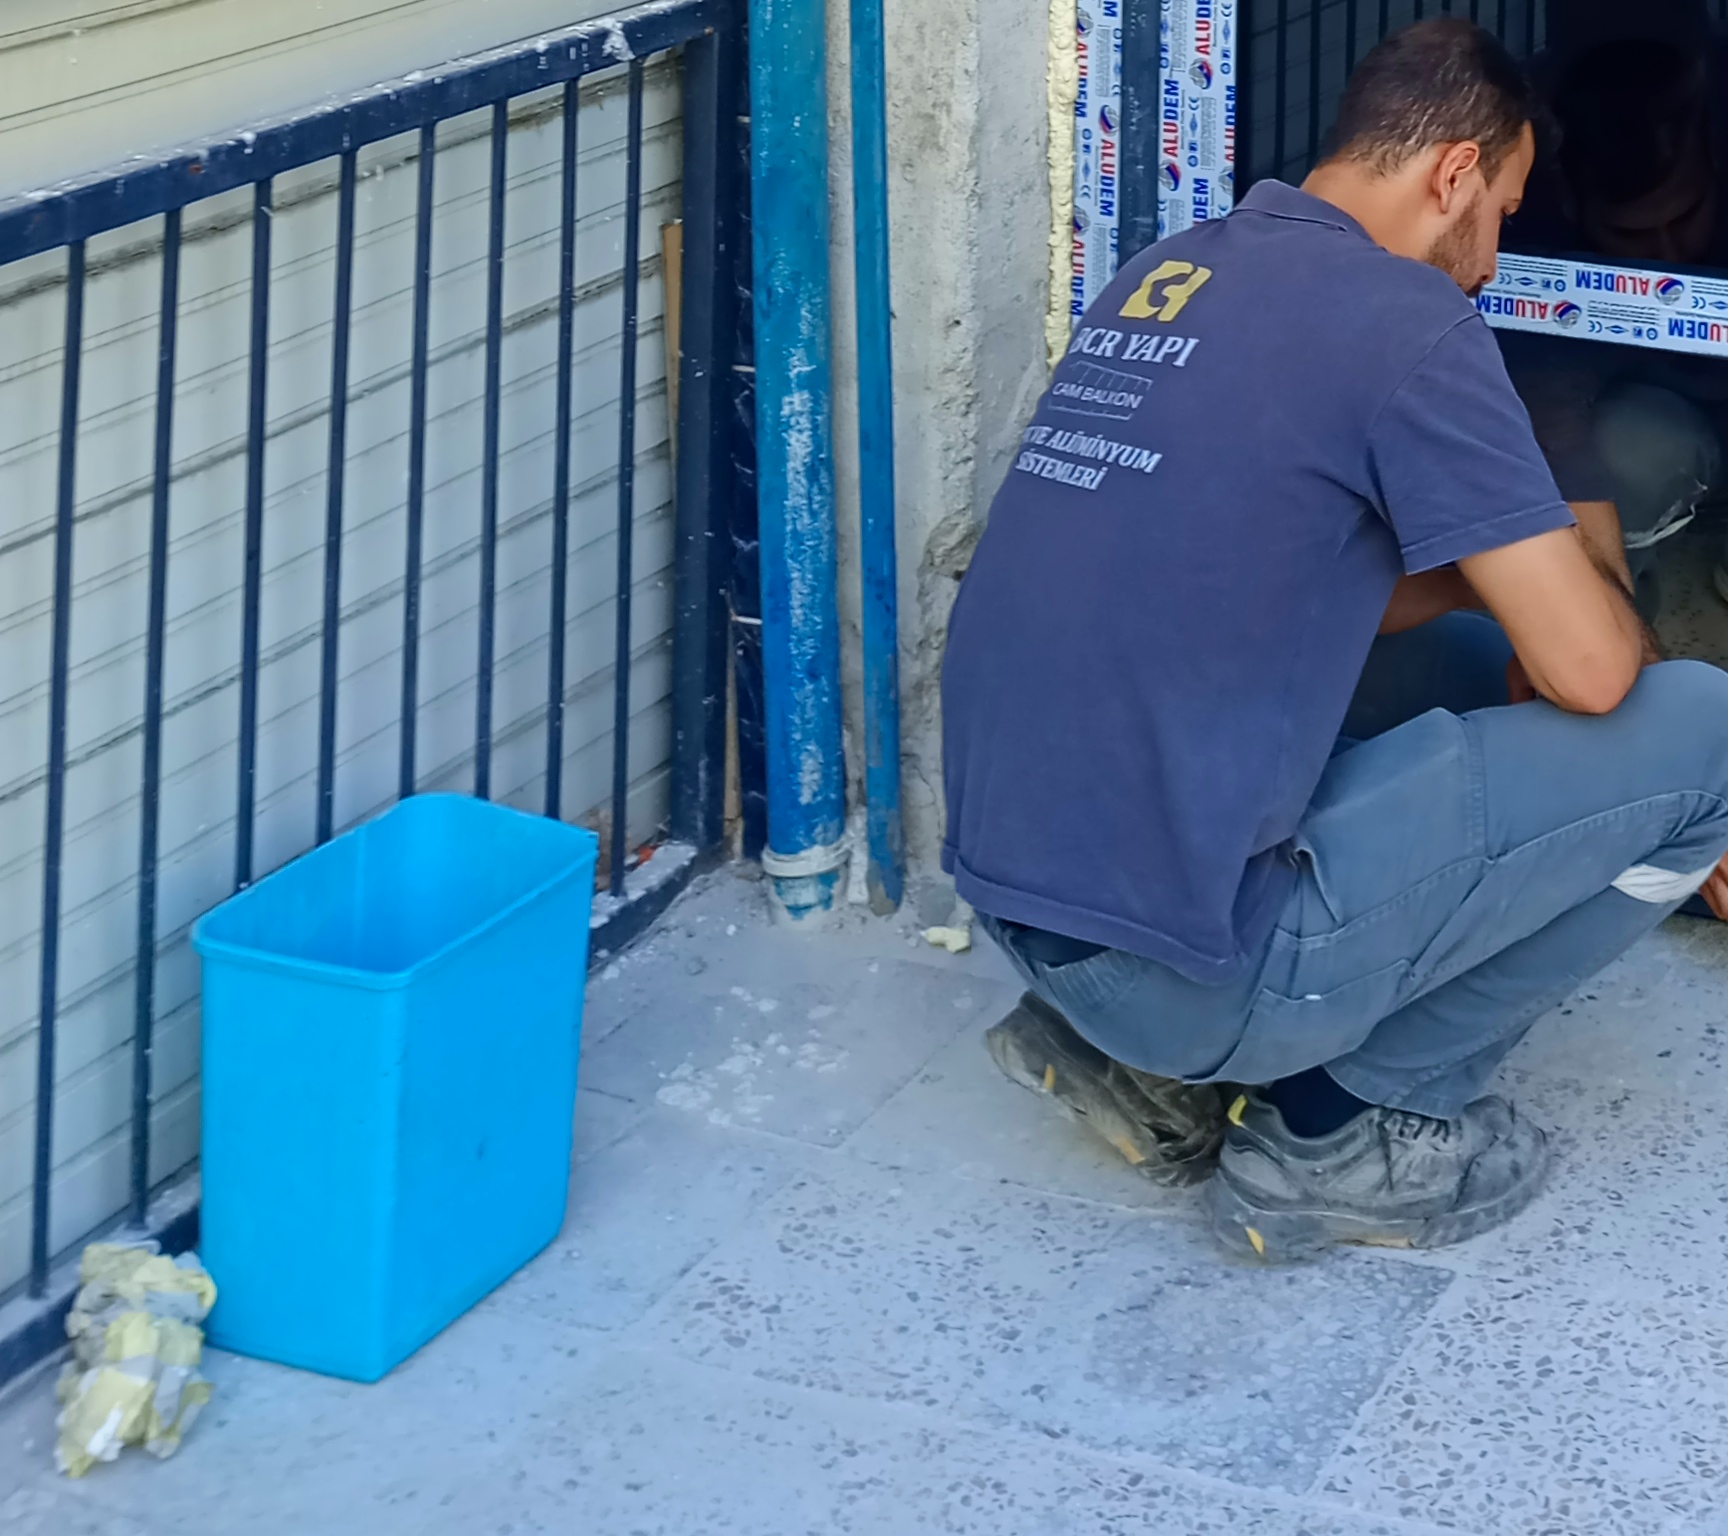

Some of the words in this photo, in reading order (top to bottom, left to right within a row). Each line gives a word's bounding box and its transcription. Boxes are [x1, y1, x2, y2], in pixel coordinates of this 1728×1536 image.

[1163, 79, 1179, 157] ALUDEM
[1099, 139, 1116, 216] ALUDEM
[1191, 178, 1208, 225] DEM
[1575, 269, 1650, 295] ALUDEM
[1121, 333, 1200, 367] YAPI
